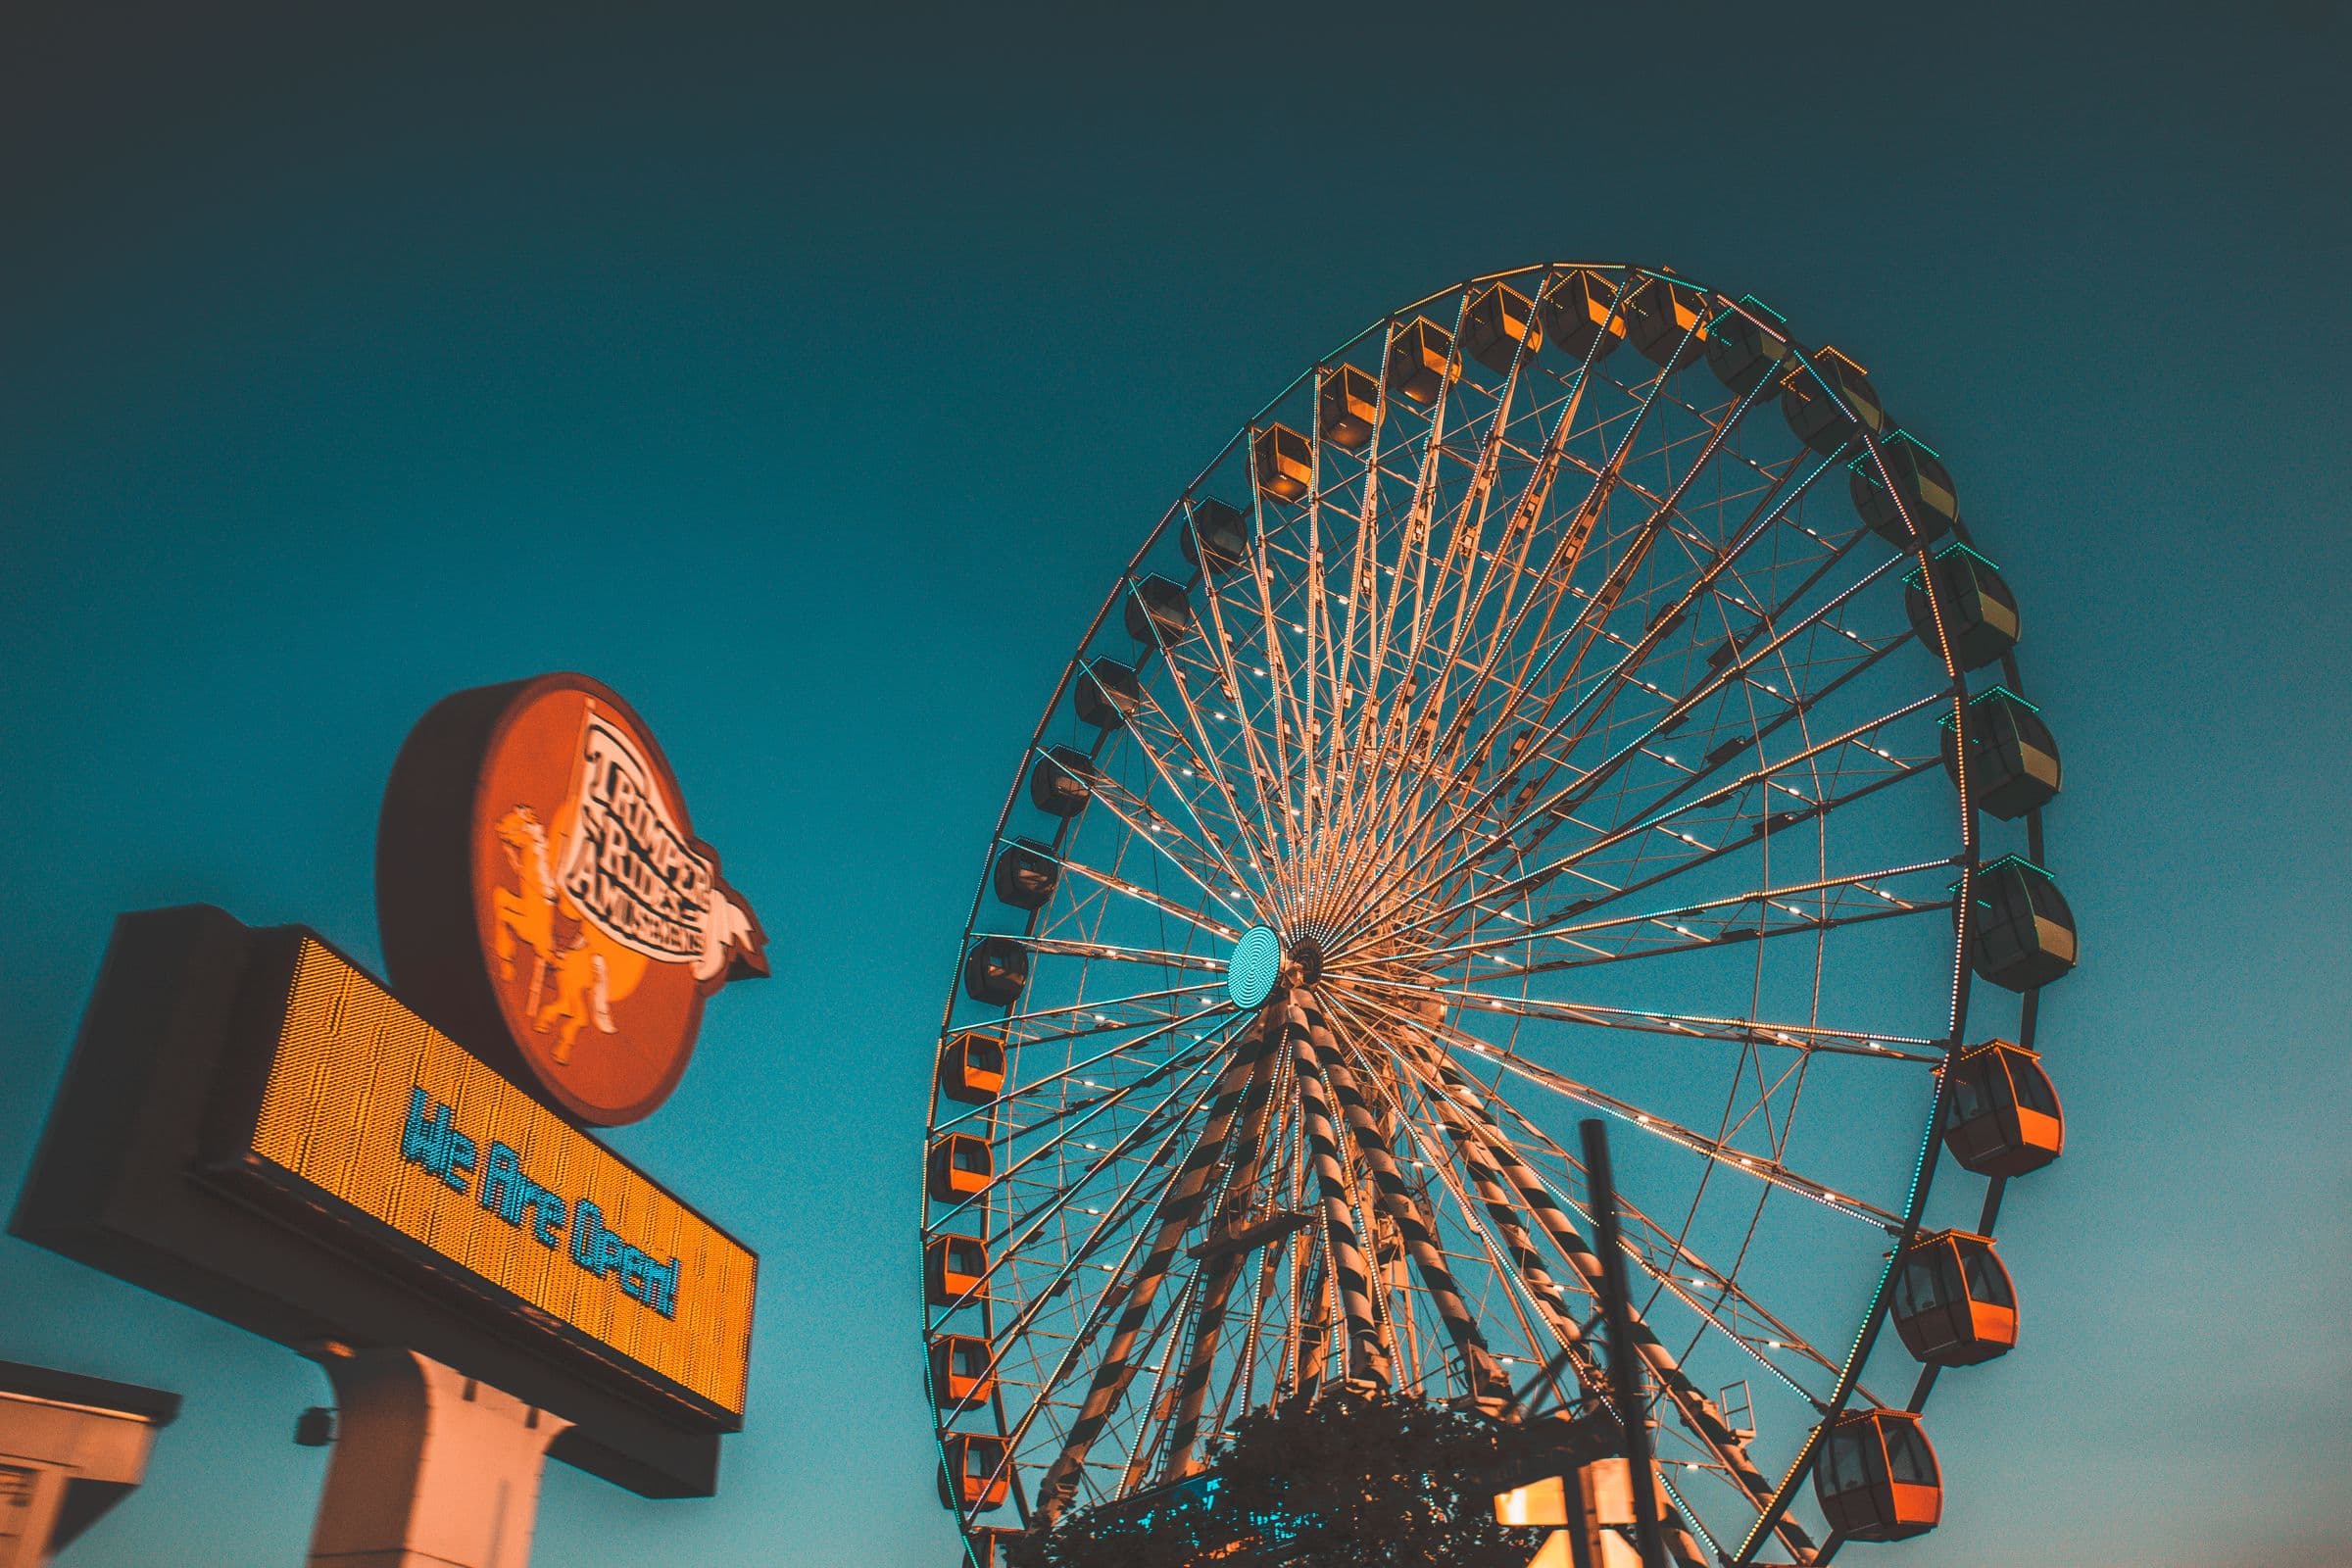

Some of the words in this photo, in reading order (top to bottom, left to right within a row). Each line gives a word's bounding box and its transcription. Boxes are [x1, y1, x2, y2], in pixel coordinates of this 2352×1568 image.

[599, 812, 684, 919] RIDES
[403, 1089, 476, 1190] We
[480, 1141, 564, 1249] Are
